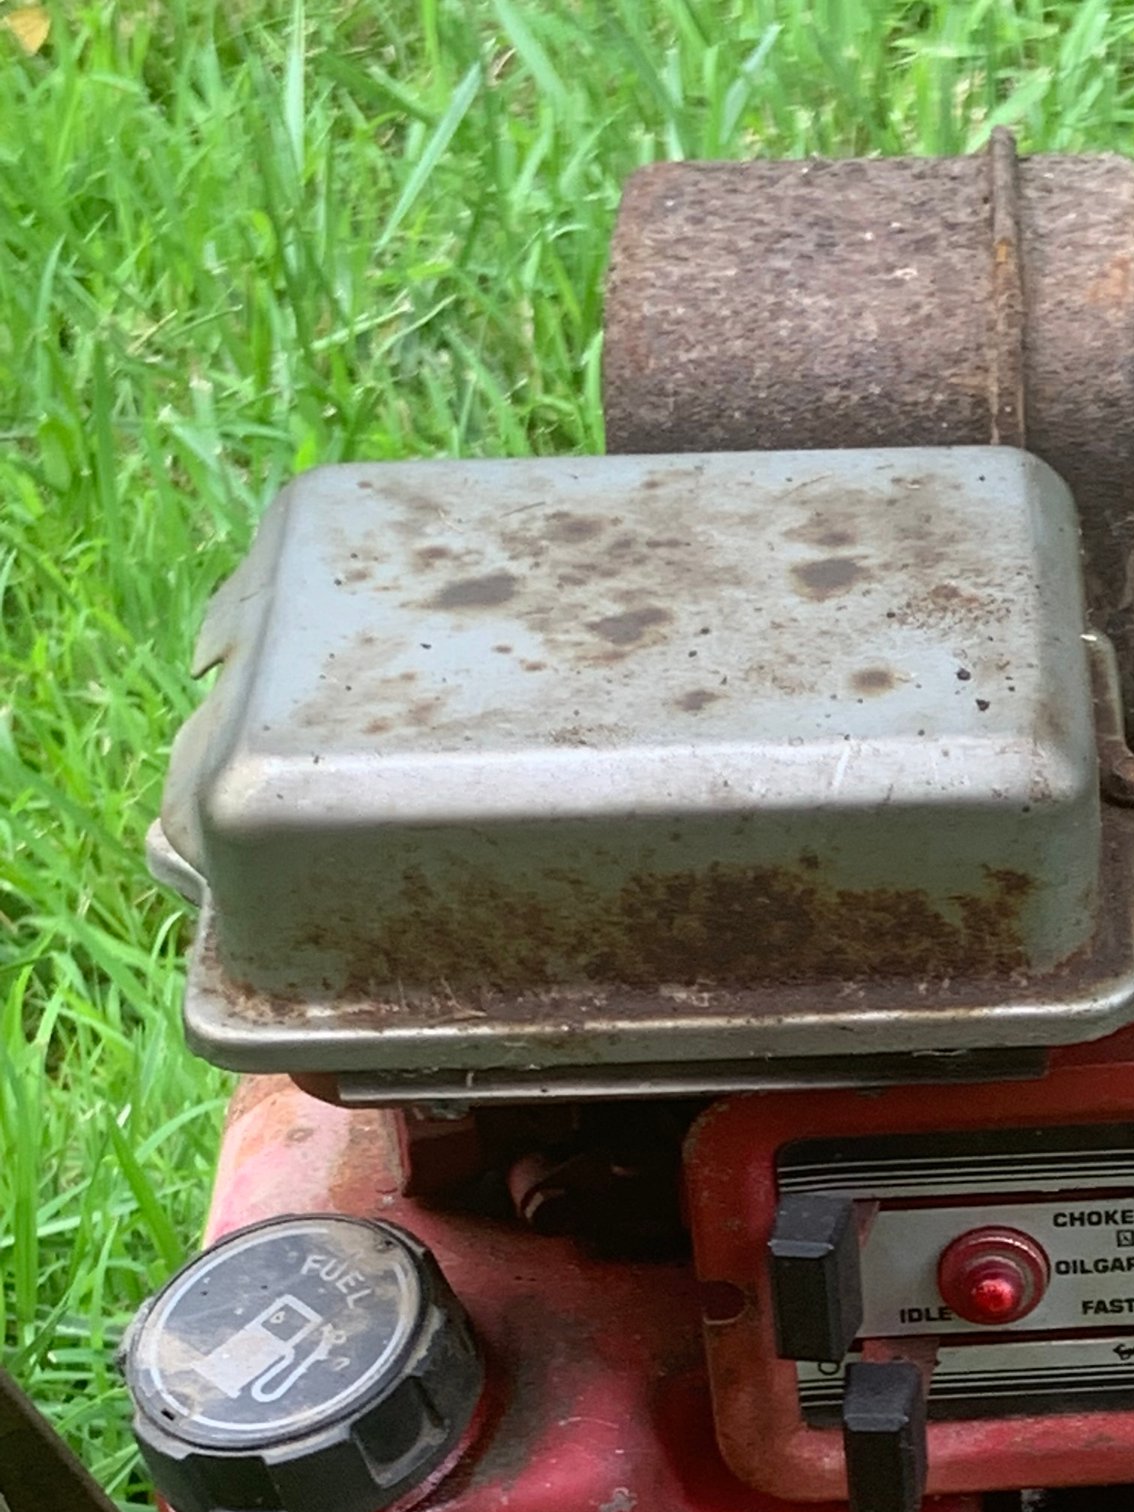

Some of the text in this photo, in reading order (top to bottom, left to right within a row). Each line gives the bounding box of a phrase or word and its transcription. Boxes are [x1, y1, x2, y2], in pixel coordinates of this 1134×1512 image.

[1052, 1208, 1134, 1228] CHOKE
[301, 1253, 374, 1309] FUEL
[899, 1306, 953, 1324] IDLE
